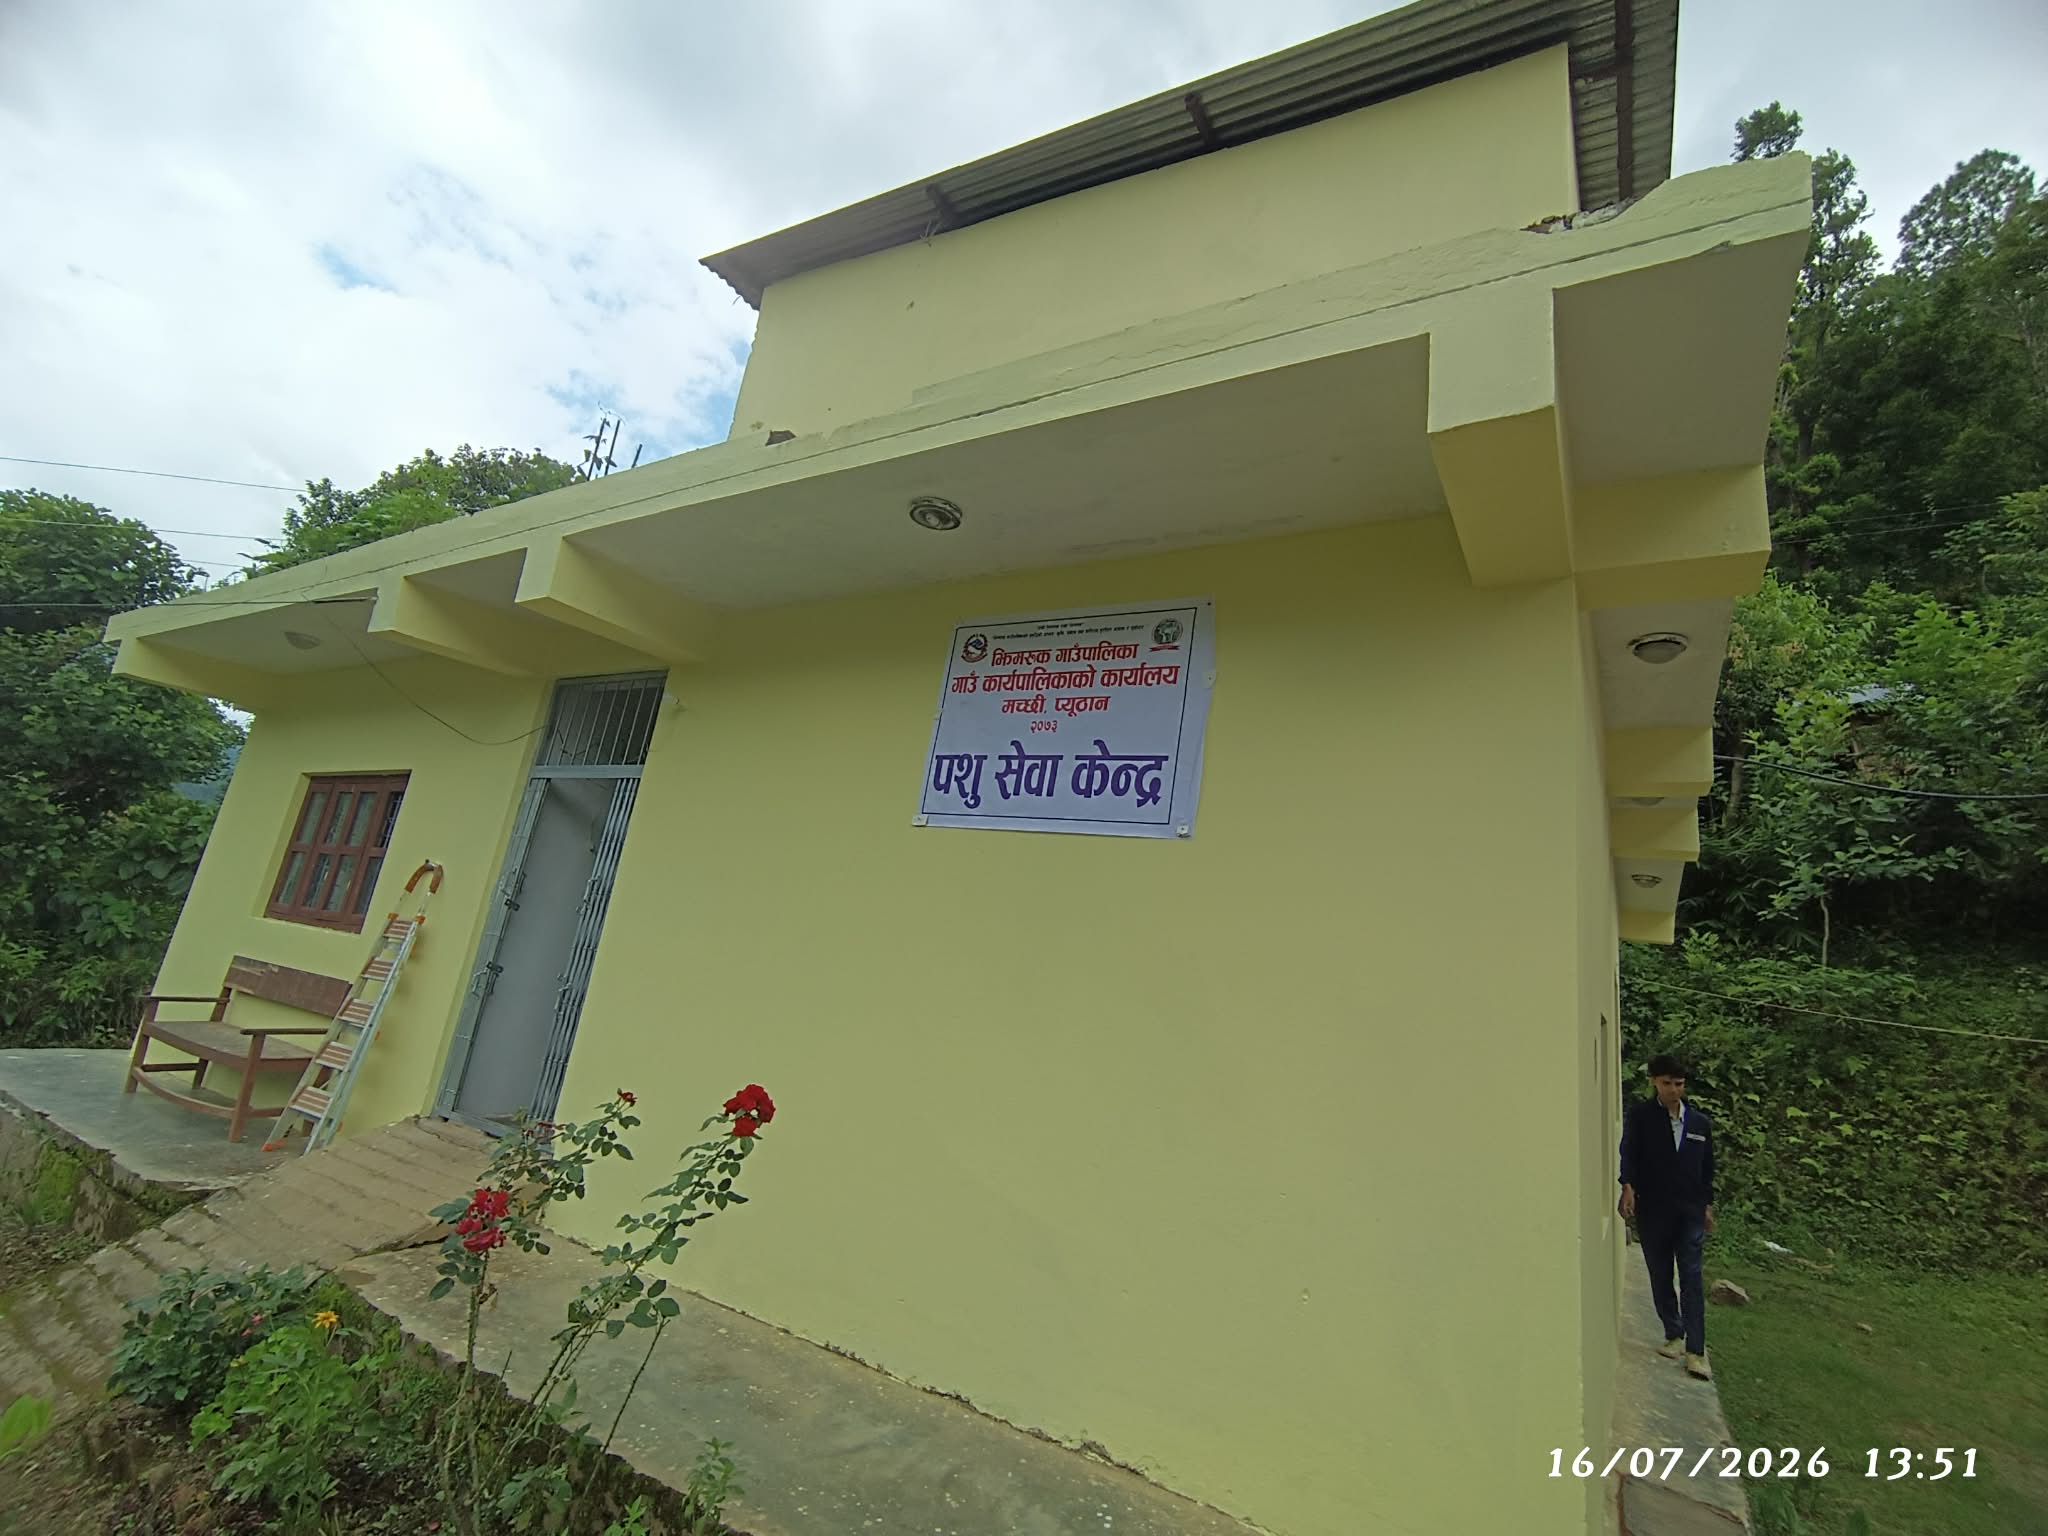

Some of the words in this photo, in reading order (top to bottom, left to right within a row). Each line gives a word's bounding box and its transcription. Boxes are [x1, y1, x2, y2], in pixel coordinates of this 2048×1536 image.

[991, 647, 1052, 666] झिमरुक
[1056, 640, 1139, 663] गाउँपालिका
[952, 670, 980, 694] गाउँ
[982, 664, 1097, 692] कार्यपालिकाको
[1100, 662, 1181, 687] कार्यालय
[1054, 695, 1111, 717] प्यूठान
[1030, 719, 1058, 733] २०७३
[932, 752, 987, 809] पशु
[994, 739, 1064, 801] सेवा
[1070, 739, 1169, 808] केन्द्र
